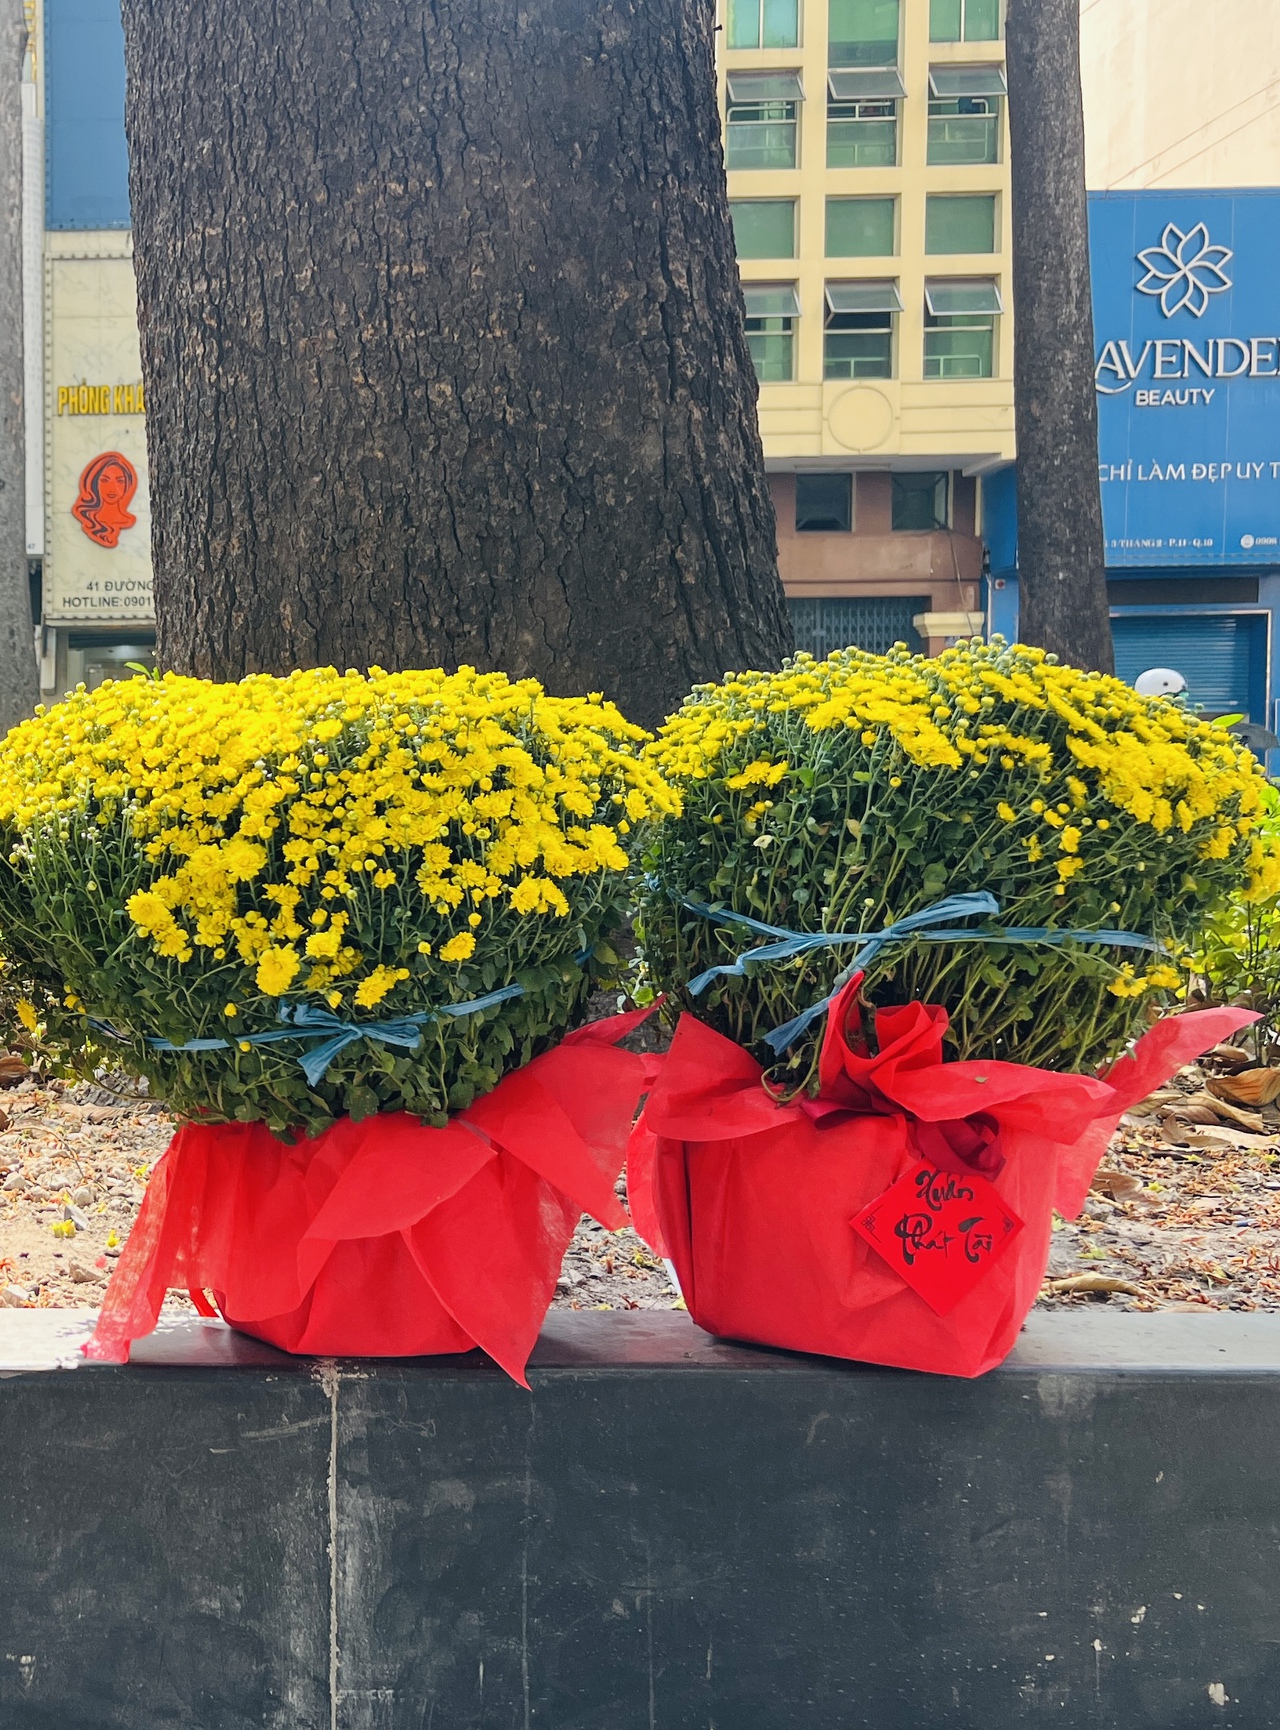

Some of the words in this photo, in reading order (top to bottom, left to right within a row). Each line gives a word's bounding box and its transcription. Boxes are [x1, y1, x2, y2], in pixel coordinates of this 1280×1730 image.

[1094, 337, 1280, 395] AVENDE
[57, 377, 111, 417] PHÒNG
[1135, 387, 1216, 407] BEAUTY
[1098, 458, 1133, 482] CHỈ
[1137, 459, 1187, 482] LÀM
[1191, 461, 1232, 484] ĐẸP
[1236, 461, 1265, 480] UY
[86, 581, 99, 592] 41
